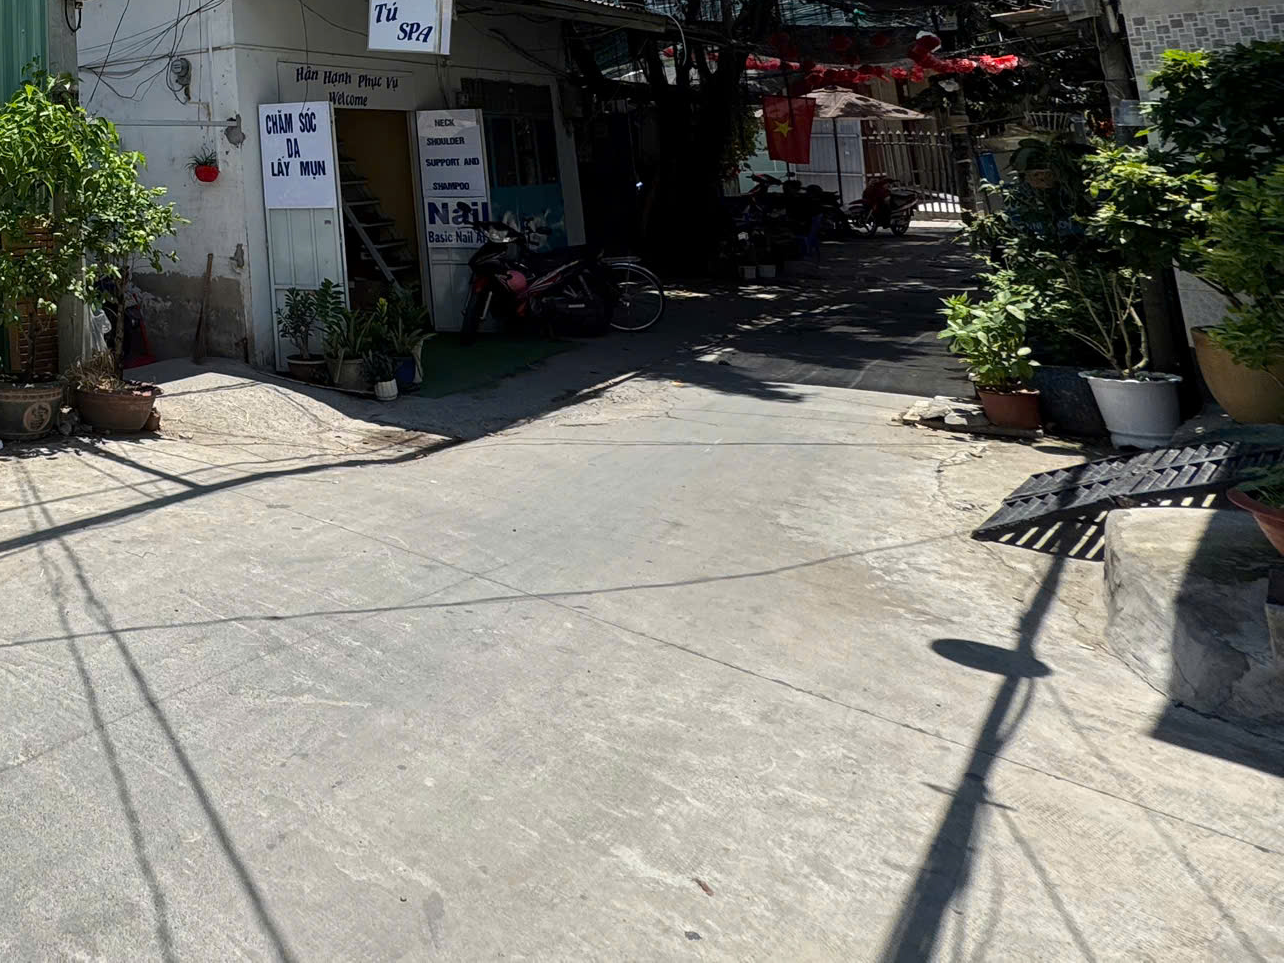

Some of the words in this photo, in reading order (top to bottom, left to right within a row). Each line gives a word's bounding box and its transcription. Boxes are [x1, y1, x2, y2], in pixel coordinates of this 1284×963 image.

[375, 2, 398, 23] Tú
[397, 22, 433, 43] SPA
[323, 70, 352, 87] Hạnh
[386, 76, 399, 91] Vụ
[329, 91, 368, 106] Welcome
[265, 109, 293, 135] CHĂM
[299, 107, 317, 133] SÓC
[434, 118, 456, 127] NECK
[286, 138, 301, 158] DA
[426, 137, 465, 146] SHOULDER
[271, 156, 290, 176] LẤY
[299, 160, 326, 180] MỤN
[425, 158, 460, 167] SUPPORT
[464, 157, 480, 166] AND
[433, 182, 470, 190] SHAMPOO
[427, 201, 490, 225] Nail
[428, 231, 454, 244] Basic
[456, 231, 474, 244] Nail
